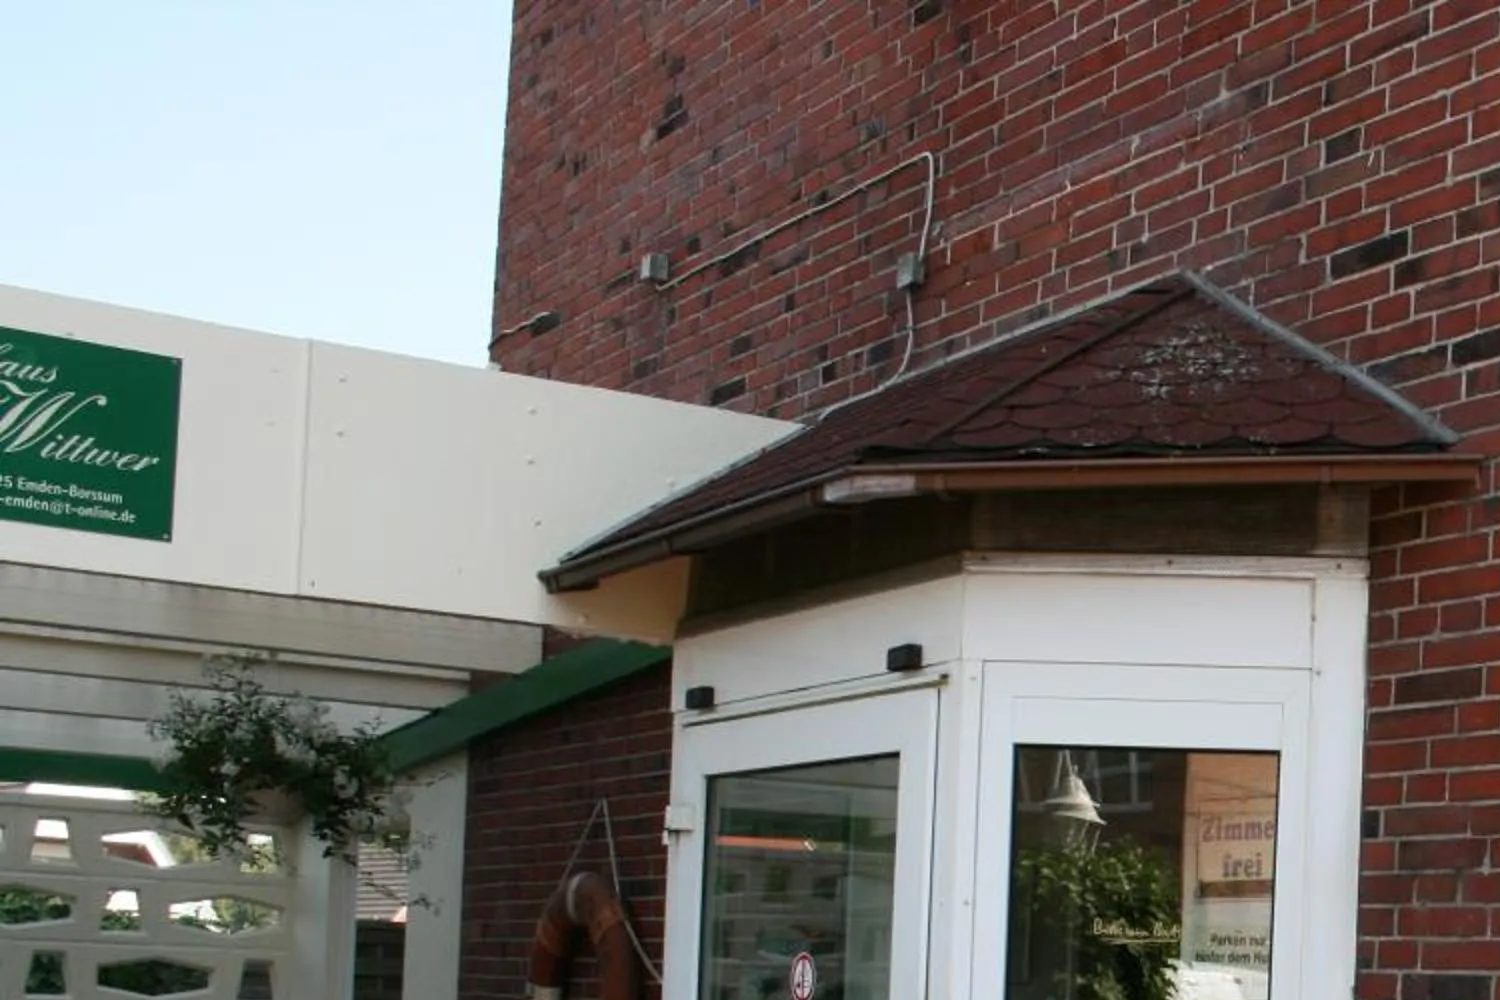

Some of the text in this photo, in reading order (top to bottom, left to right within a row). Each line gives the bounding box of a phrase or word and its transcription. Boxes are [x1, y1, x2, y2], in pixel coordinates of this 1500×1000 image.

[0, 352, 57, 383] aus
[0, 380, 160, 471] Wittwer
[17, 476, 123, 504] Emden-Borssum
[1202, 816, 1275, 842] Zimme
